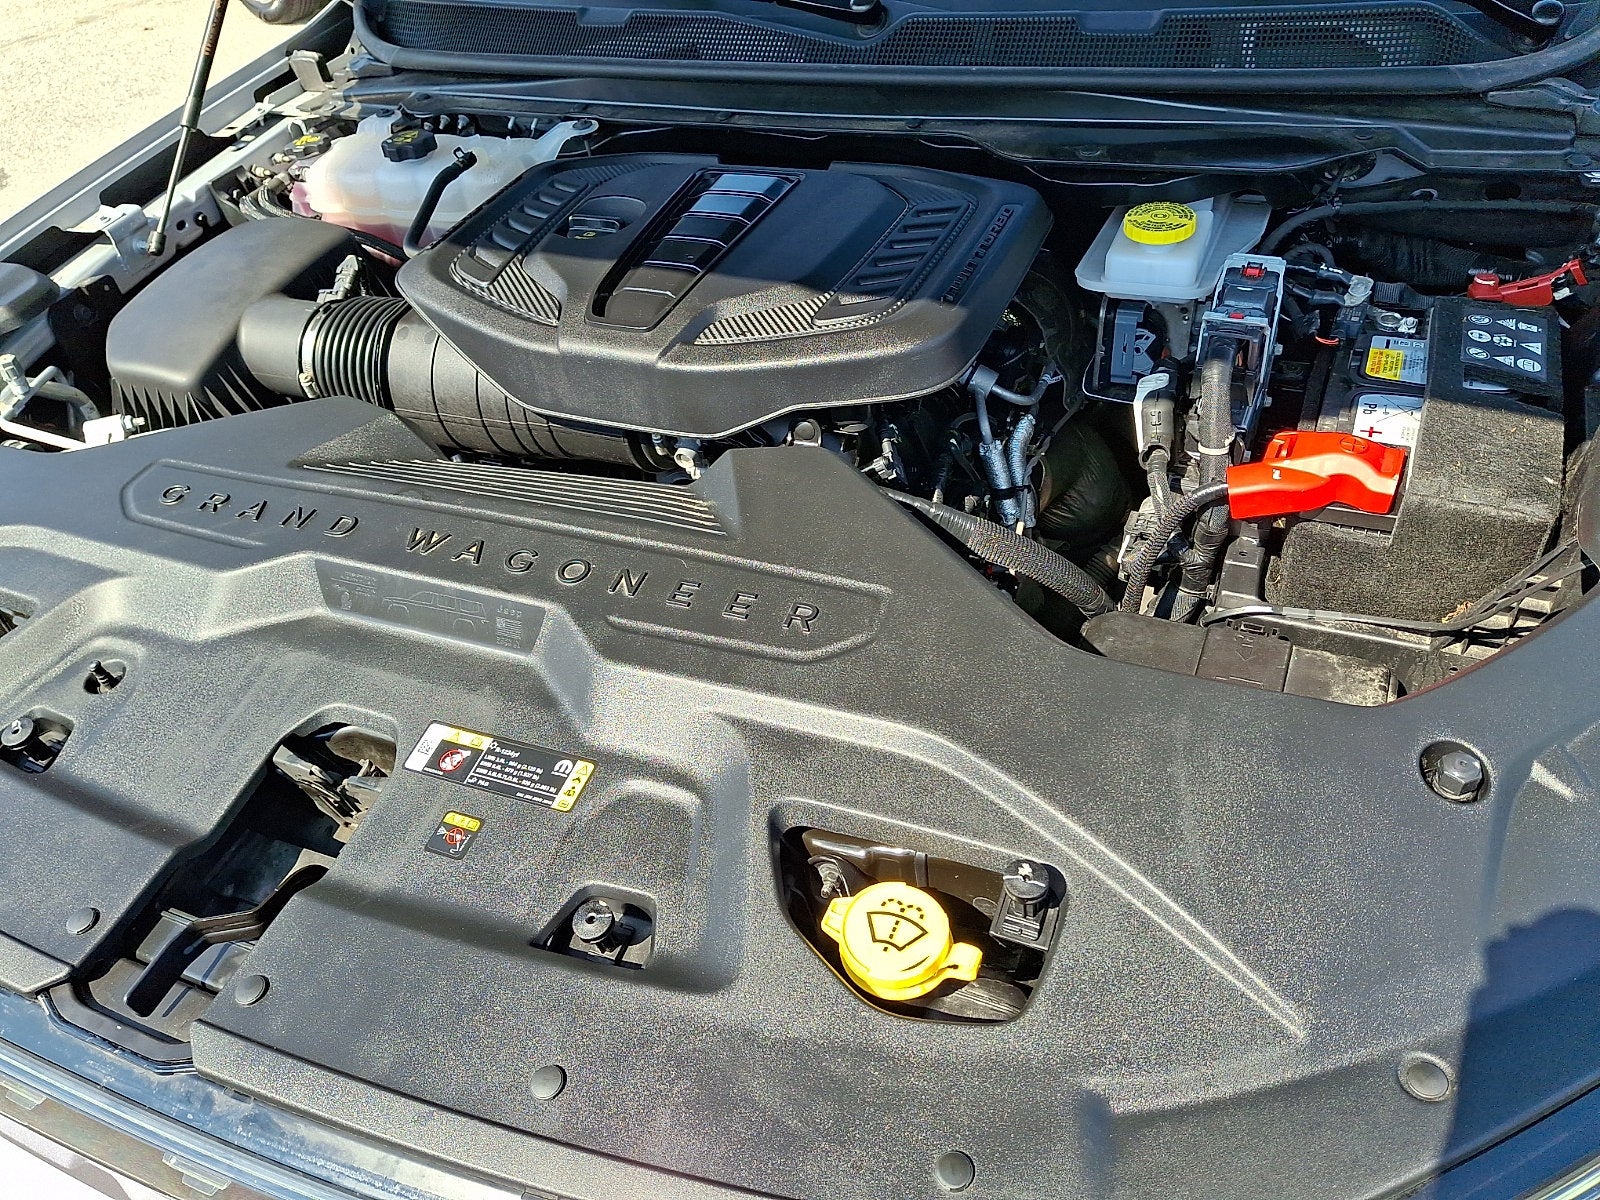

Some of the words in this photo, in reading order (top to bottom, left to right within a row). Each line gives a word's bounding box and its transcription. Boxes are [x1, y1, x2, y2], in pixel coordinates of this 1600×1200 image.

[1363, 402, 1378, 415] Pb
[159, 484, 360, 538] GRAND
[406, 527, 821, 634] WAGONEER
